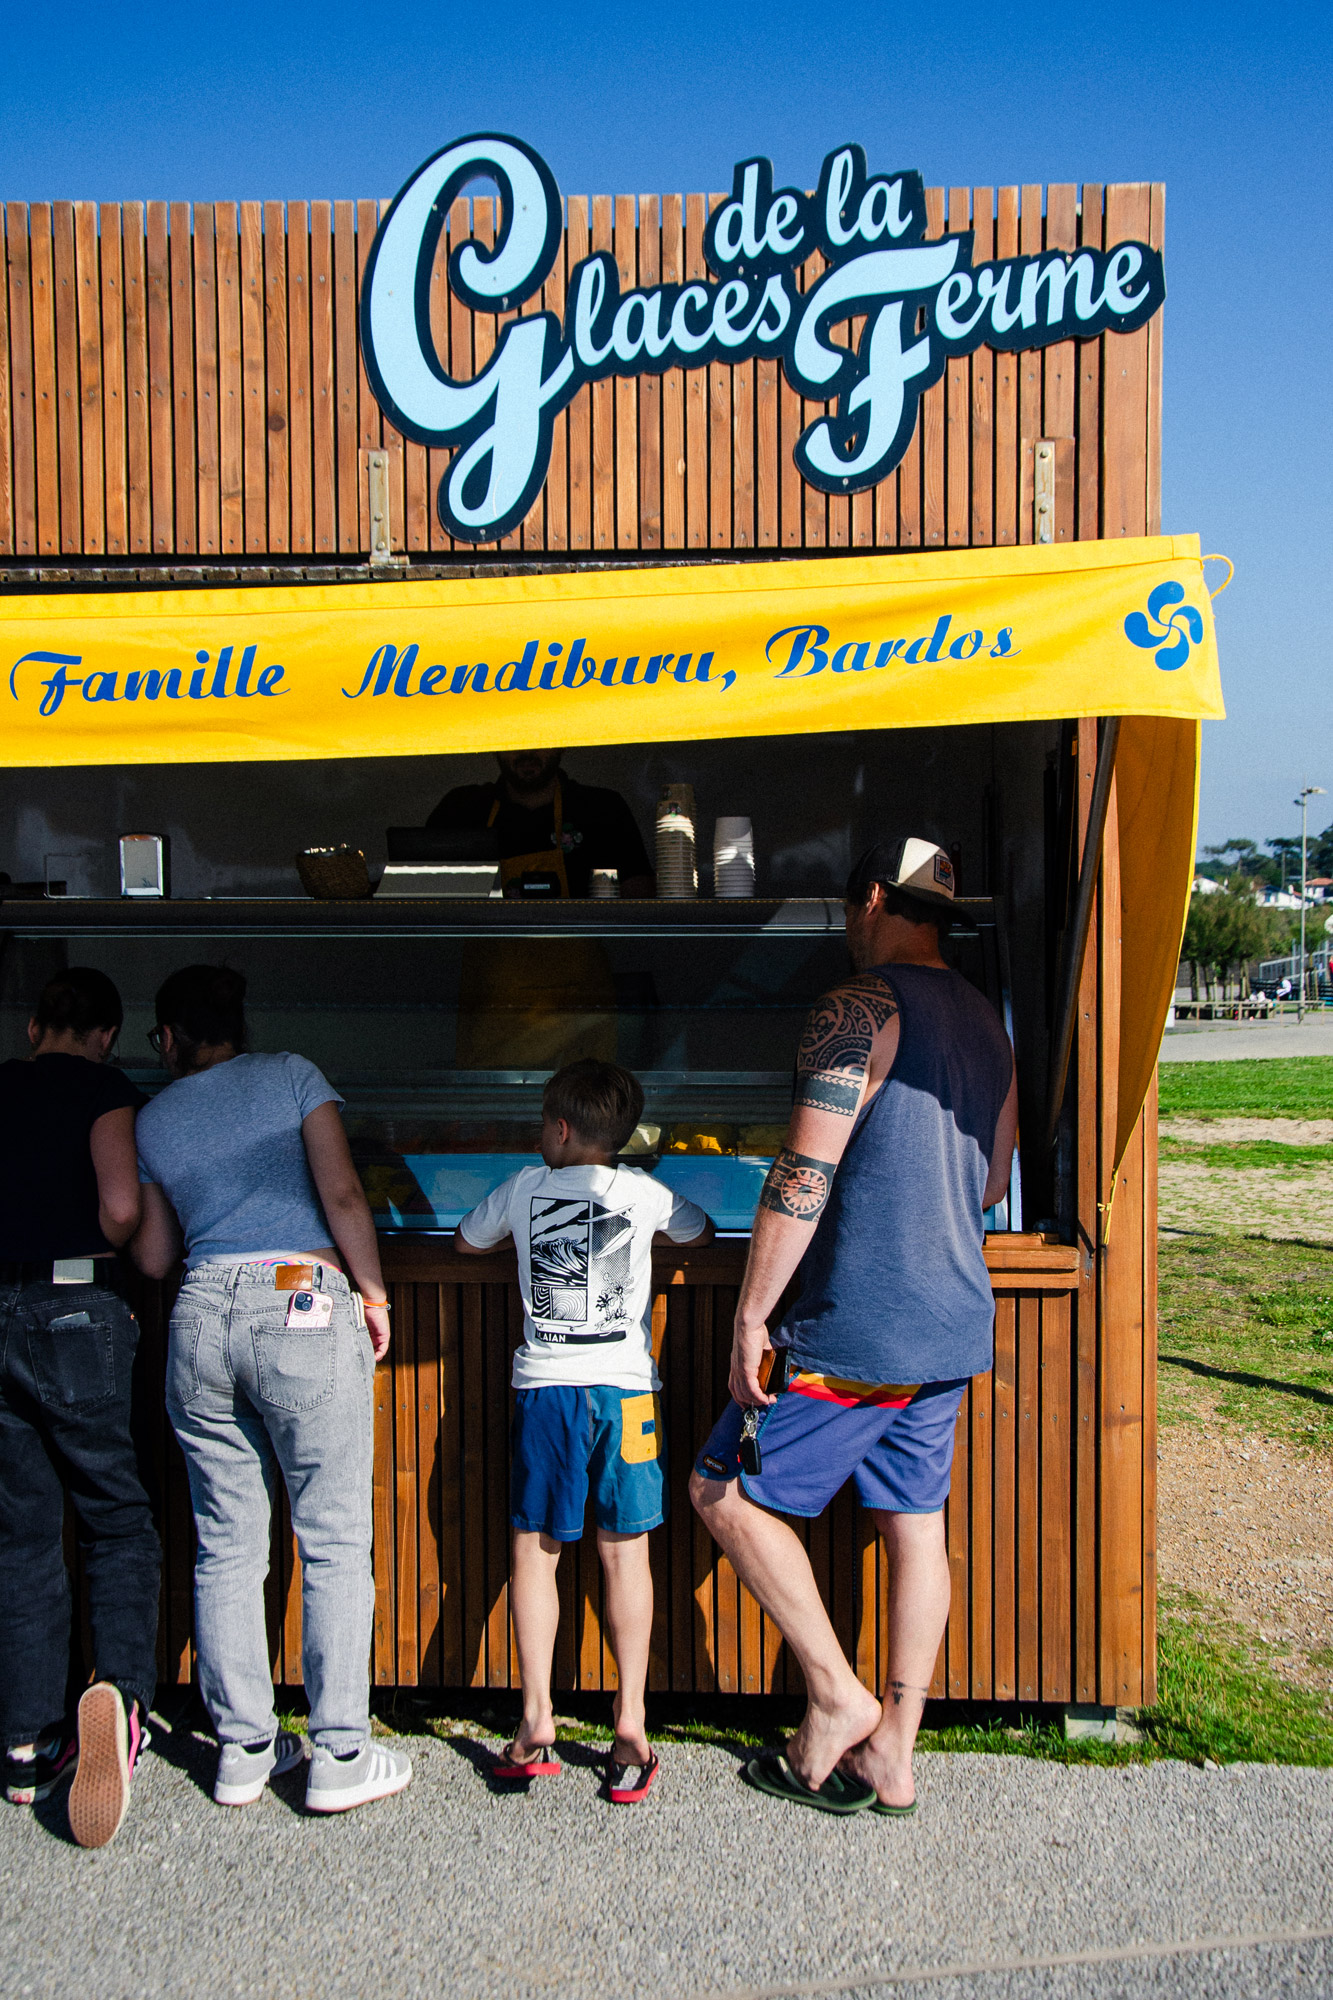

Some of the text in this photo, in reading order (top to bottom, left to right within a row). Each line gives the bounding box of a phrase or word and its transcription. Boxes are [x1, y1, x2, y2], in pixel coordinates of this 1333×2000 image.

[715, 149, 913, 261] de la
[370, 140, 1150, 526] Glaces Ferme
[10, 615, 1021, 716] Famille Mendiburu, Bardos
